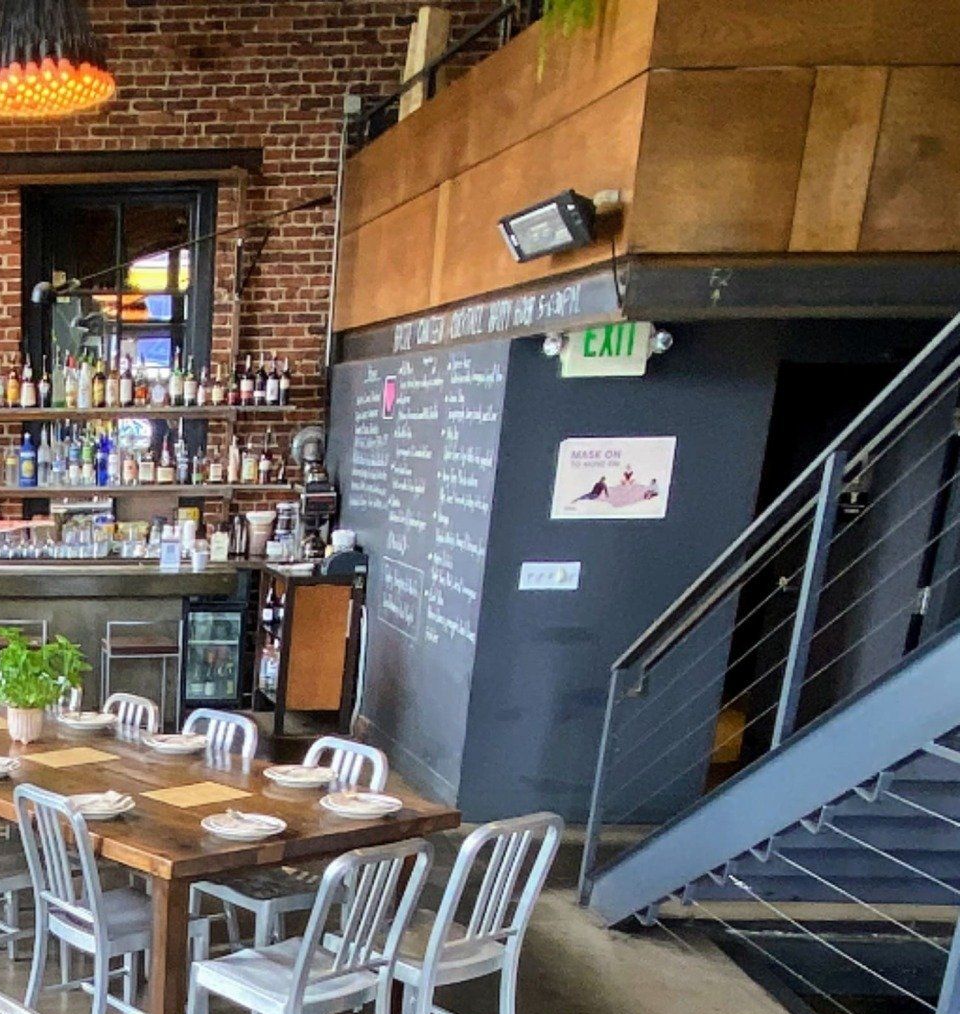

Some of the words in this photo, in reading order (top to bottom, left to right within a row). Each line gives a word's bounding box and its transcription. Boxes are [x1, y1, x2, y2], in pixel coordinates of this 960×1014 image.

[583, 321, 636, 357] EXIT
[571, 449, 602, 459] MASK
[604, 449, 622, 459] ON
